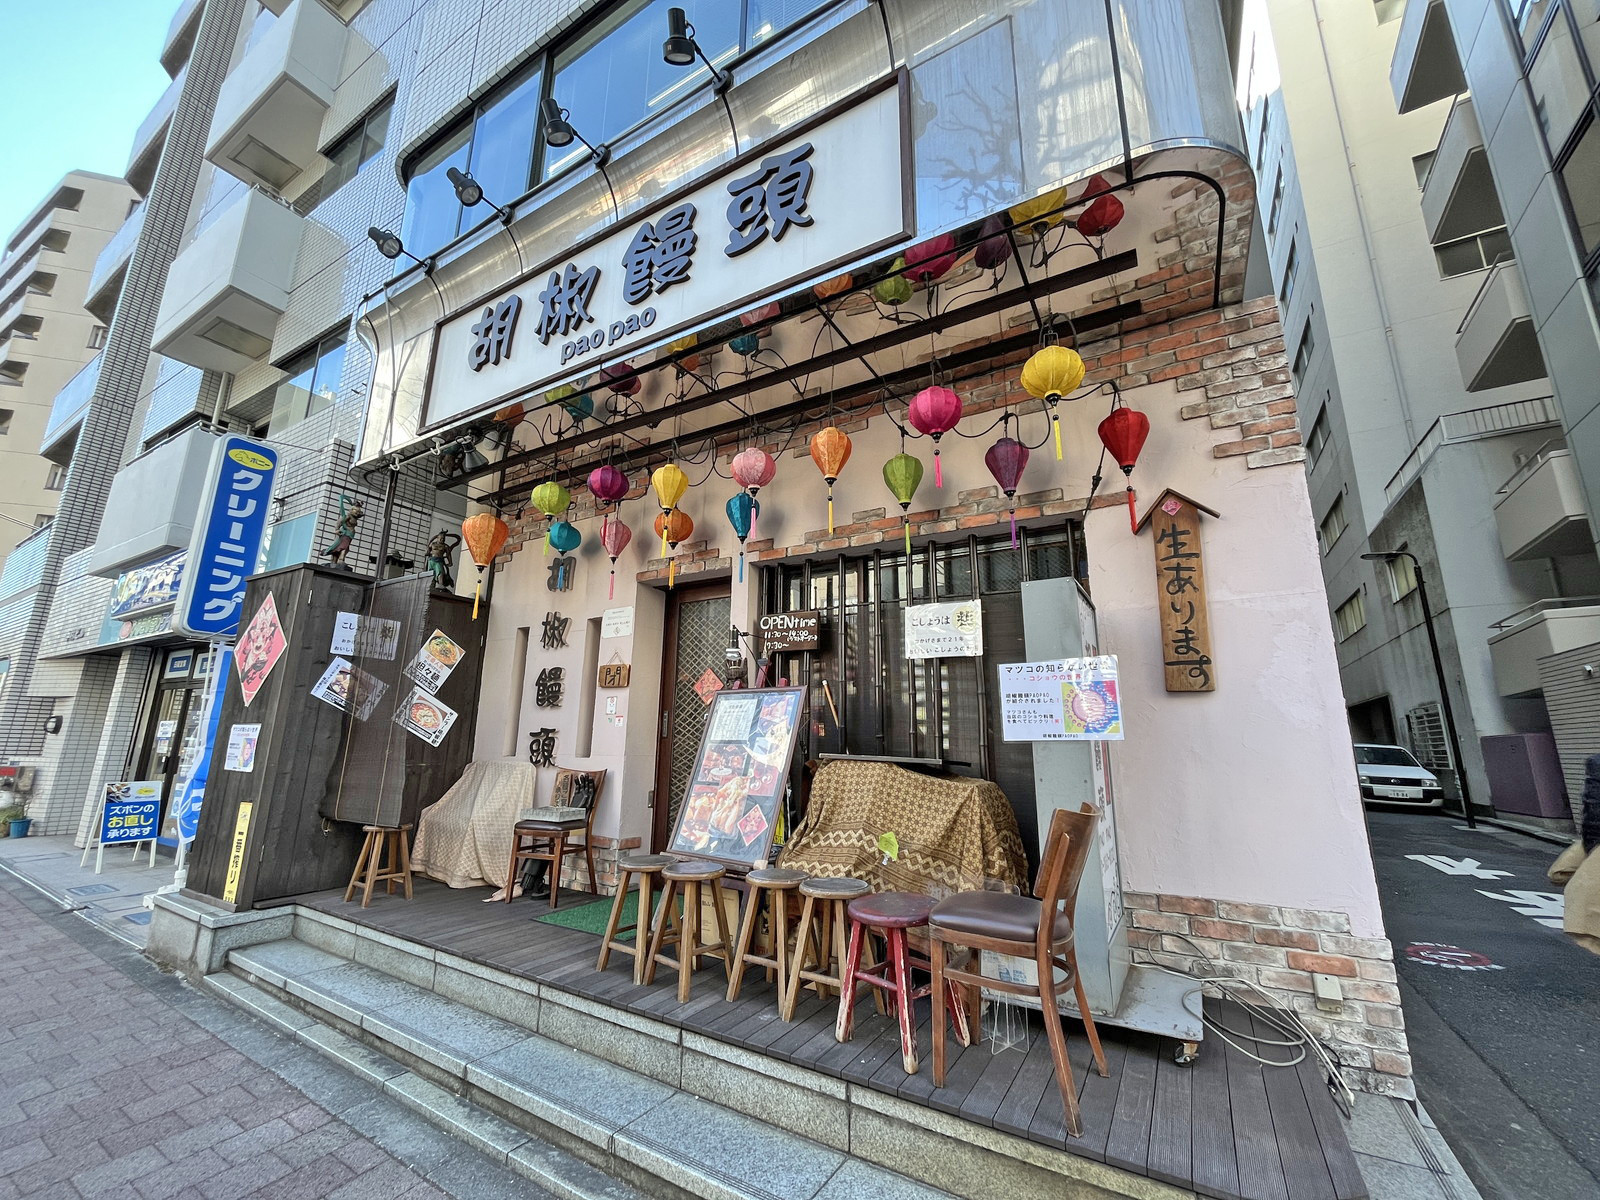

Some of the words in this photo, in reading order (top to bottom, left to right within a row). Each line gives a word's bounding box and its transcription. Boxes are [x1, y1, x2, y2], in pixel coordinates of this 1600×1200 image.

[468, 142, 815, 372] 胡椒饅頭
[560, 328, 604, 365] pao
[608, 307, 657, 341] pao
[203, 469, 263, 621] クリーニング
[1156, 523, 1212, 689] 生あります
[528, 556, 577, 768] 胡椒饅頭
[106, 826, 153, 839] 承ります
[107, 814, 154, 828] お直し
[109, 804, 155, 815] ズボンの
